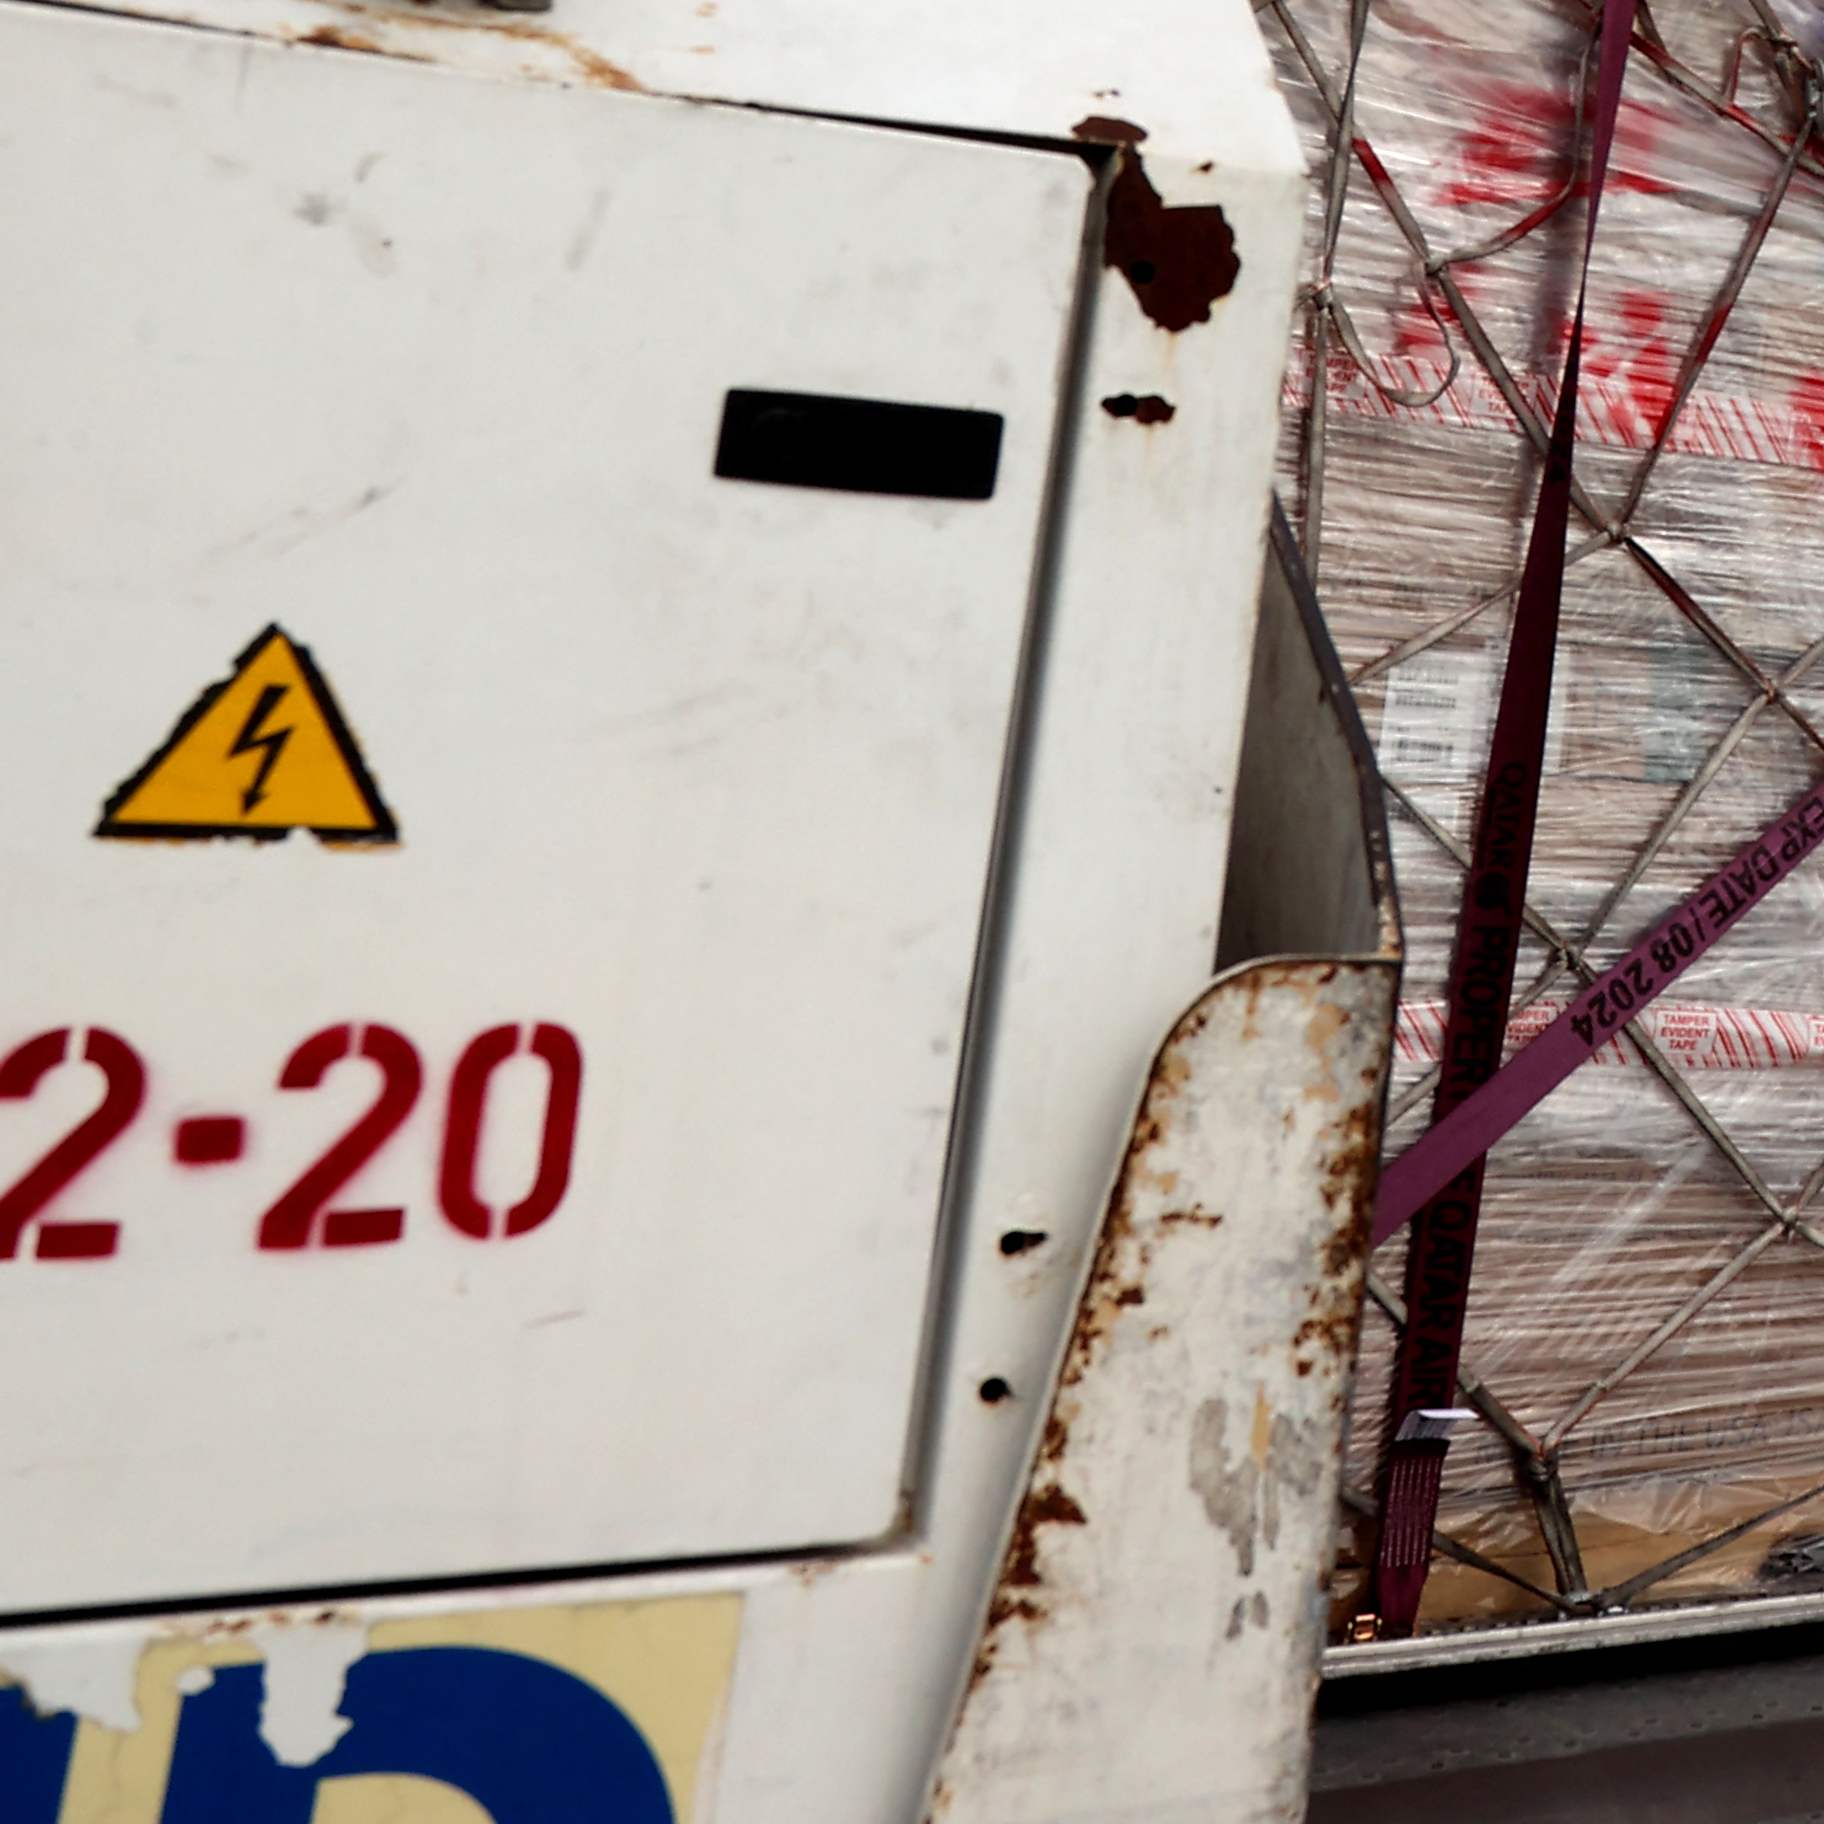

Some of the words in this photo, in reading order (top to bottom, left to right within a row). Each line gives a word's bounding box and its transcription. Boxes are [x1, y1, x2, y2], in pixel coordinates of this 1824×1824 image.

[1703, 844, 1781, 930] DATE
[1450, 923, 1510, 1102] PROPER
[1570, 956, 1655, 1048] 2024
[1664, 1014, 1710, 1025] TAMPER
[1660, 1027, 1710, 1038] EVIDENT
[1668, 1039, 1697, 1050] TAPE
